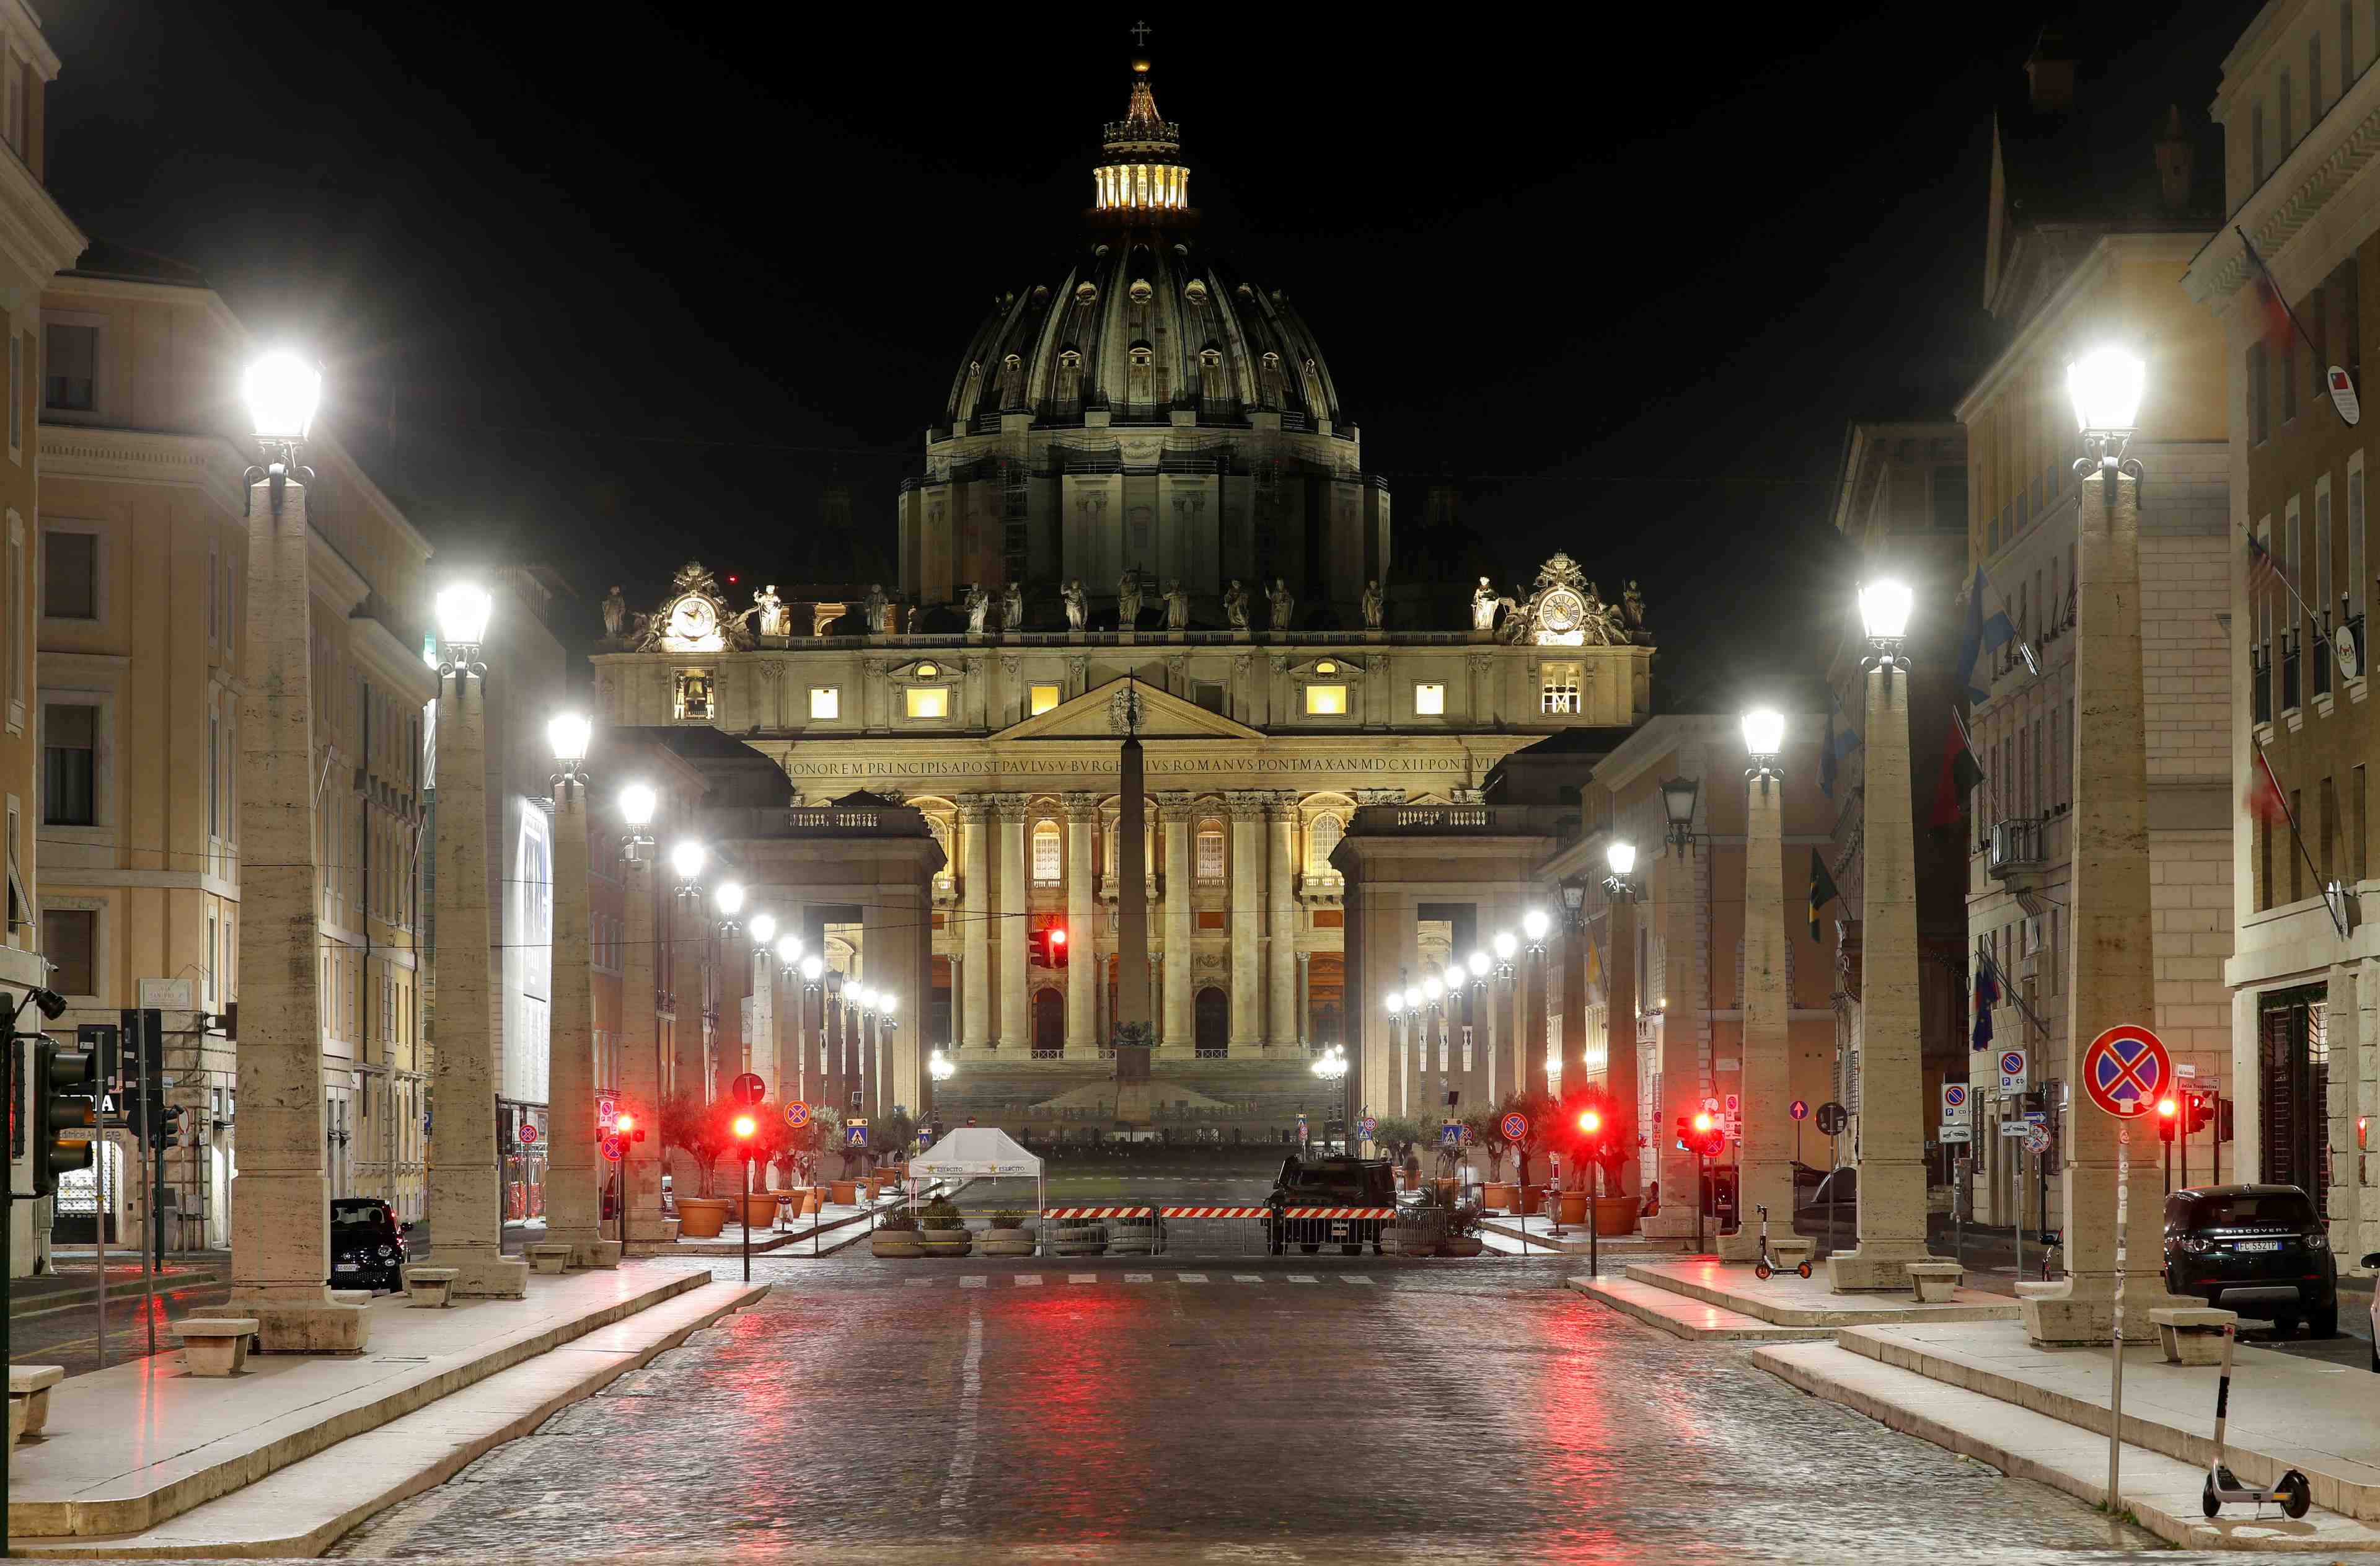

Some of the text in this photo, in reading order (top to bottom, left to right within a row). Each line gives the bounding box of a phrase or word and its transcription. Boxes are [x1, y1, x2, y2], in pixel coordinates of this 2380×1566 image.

[784, 763, 863, 774] HONOREM
[868, 762, 948, 774] PRINCIPIS
[952, 761, 999, 773] APOST
[1002, 761, 1054, 772] PAVLVS
[1174, 759, 1253, 771] ROMANVS
[1258, 758, 1298, 771] PONT
[1300, 758, 1334, 770] MAX
[1361, 758, 1424, 770] MDCXII
[1429, 758, 1470, 770] PONT
